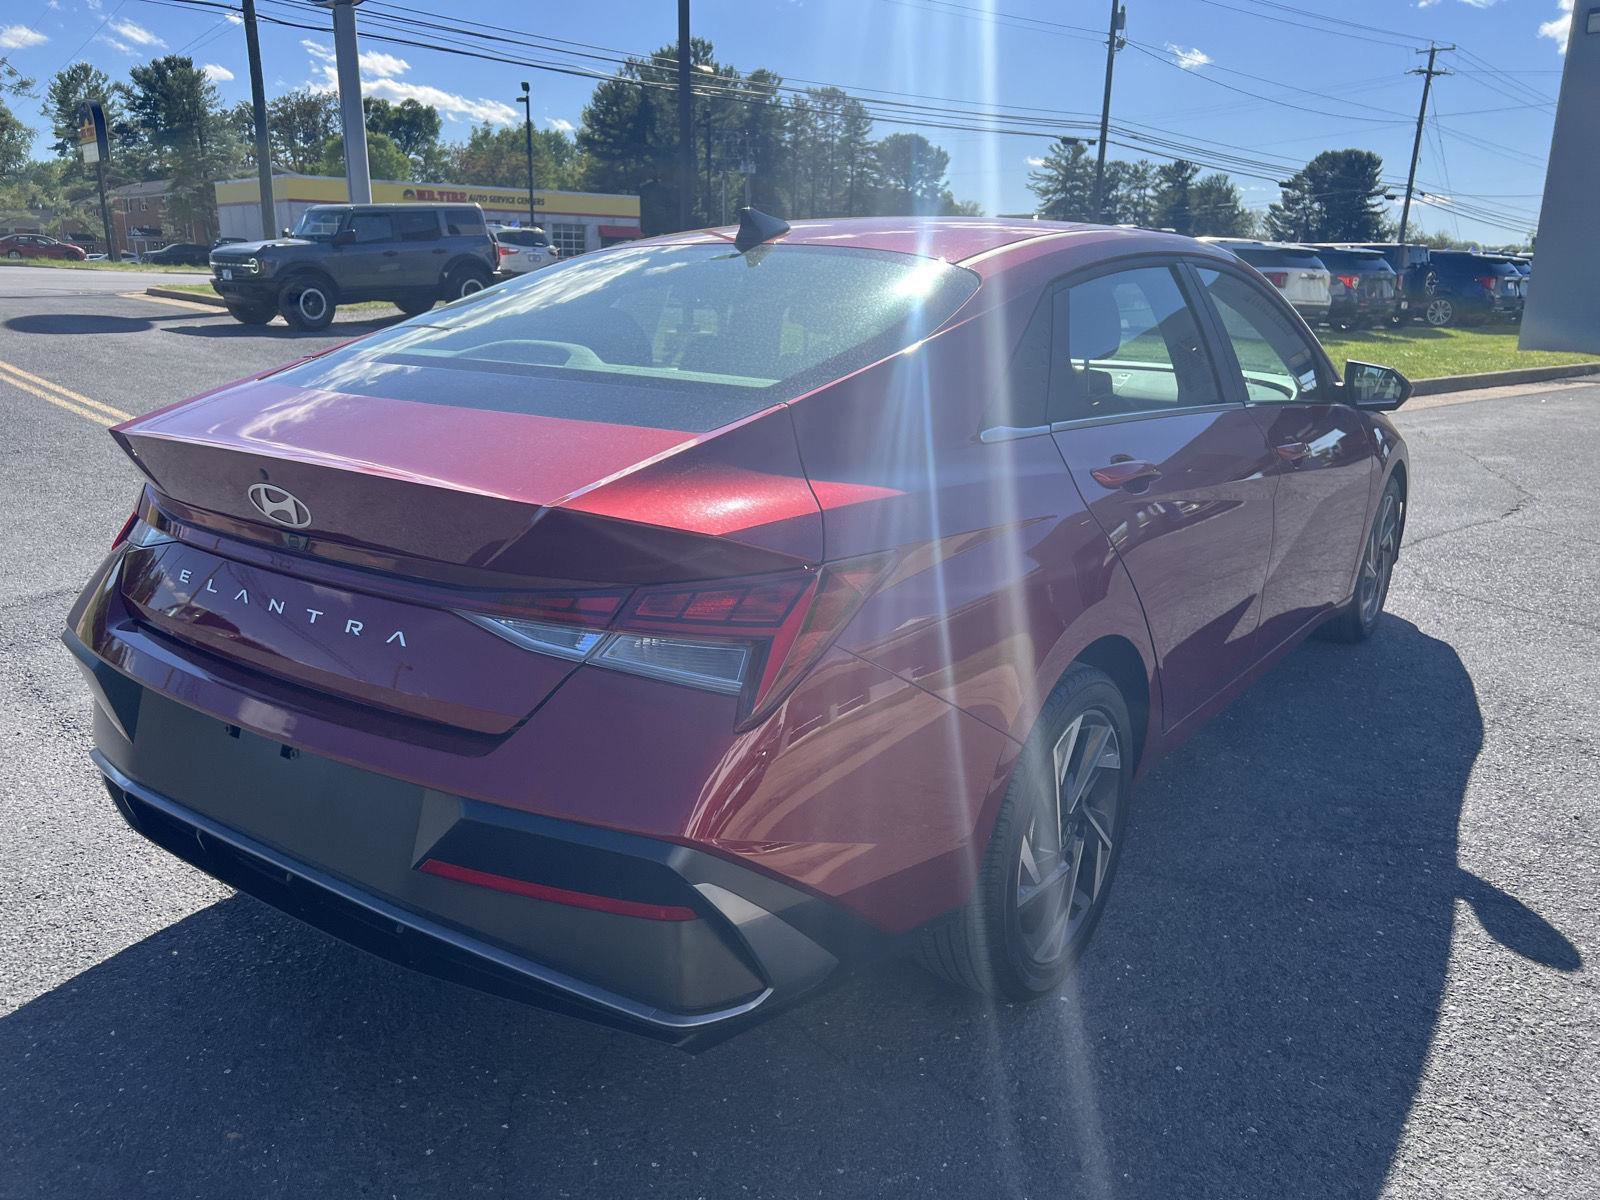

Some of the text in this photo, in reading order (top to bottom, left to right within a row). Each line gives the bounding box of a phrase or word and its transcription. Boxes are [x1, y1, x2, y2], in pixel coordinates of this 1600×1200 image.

[469, 194, 487, 202] AUTO
[489, 195, 515, 204] SERVICE
[179, 569, 408, 648] ELANTRA
